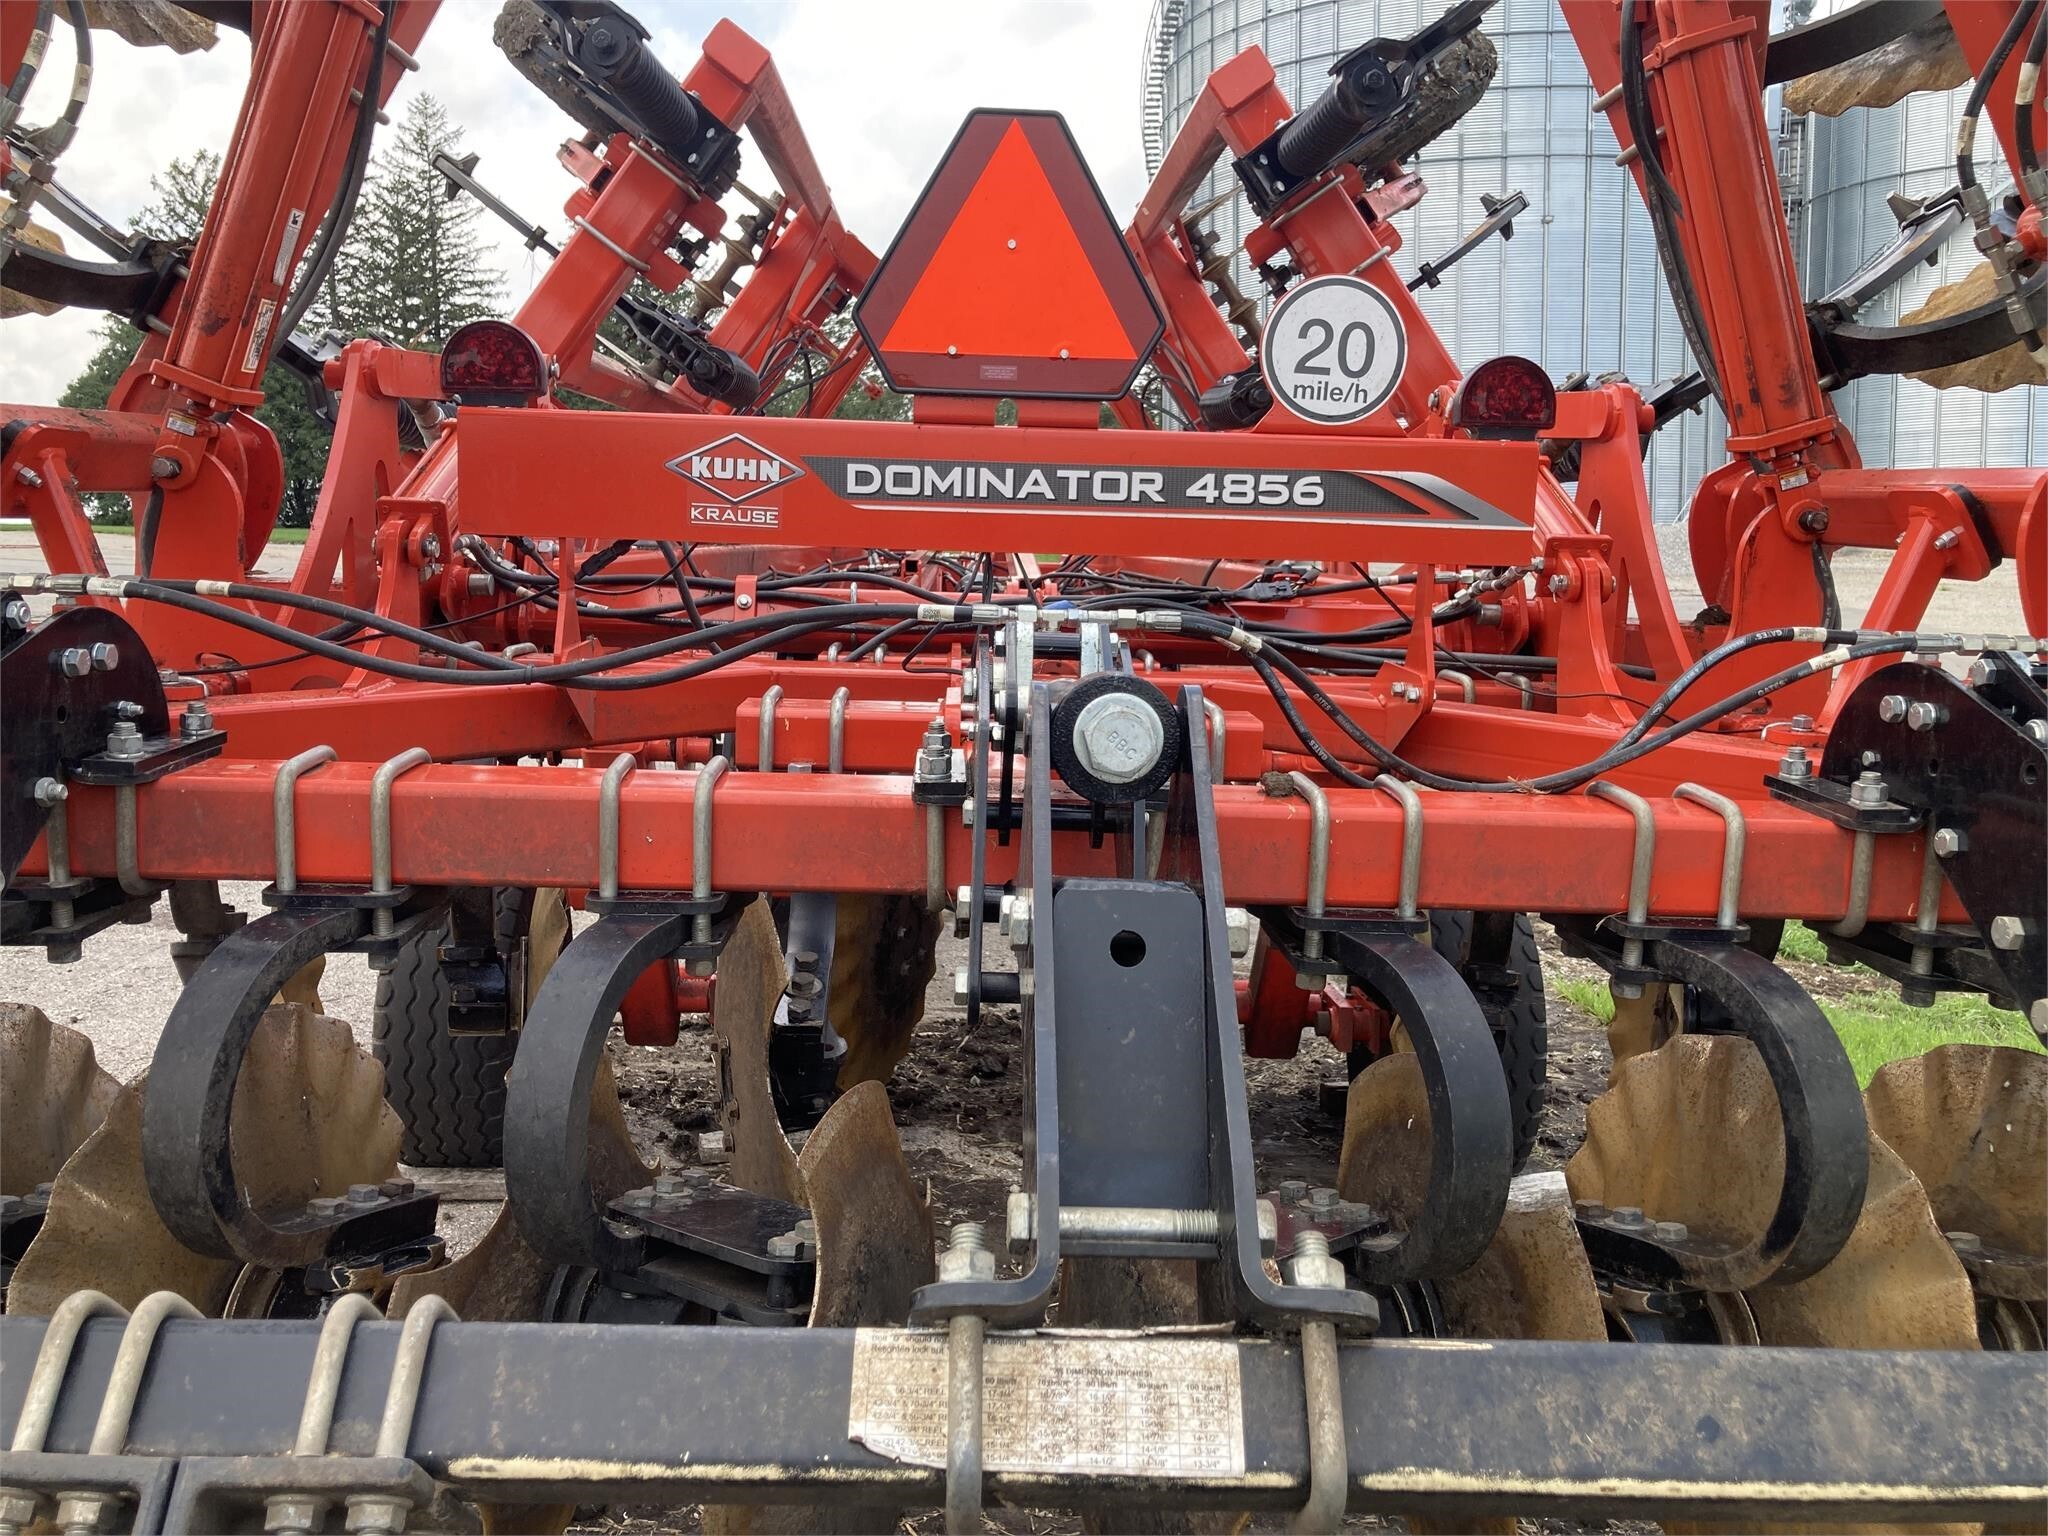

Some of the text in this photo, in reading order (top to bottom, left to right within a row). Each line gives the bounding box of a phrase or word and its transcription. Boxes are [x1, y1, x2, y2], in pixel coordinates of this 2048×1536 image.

[1293, 318, 1375, 379] 20
[1292, 381, 1368, 404] mile/h
[690, 456, 781, 484] KUHN
[846, 463, 1325, 507] DOMINATOR 4856
[690, 507, 779, 525] KRAUSE
[1106, 730, 1138, 760] BBC
[1308, 739, 1329, 761] GATES
[1066, 1368, 1113, 1377] DIMENSION
